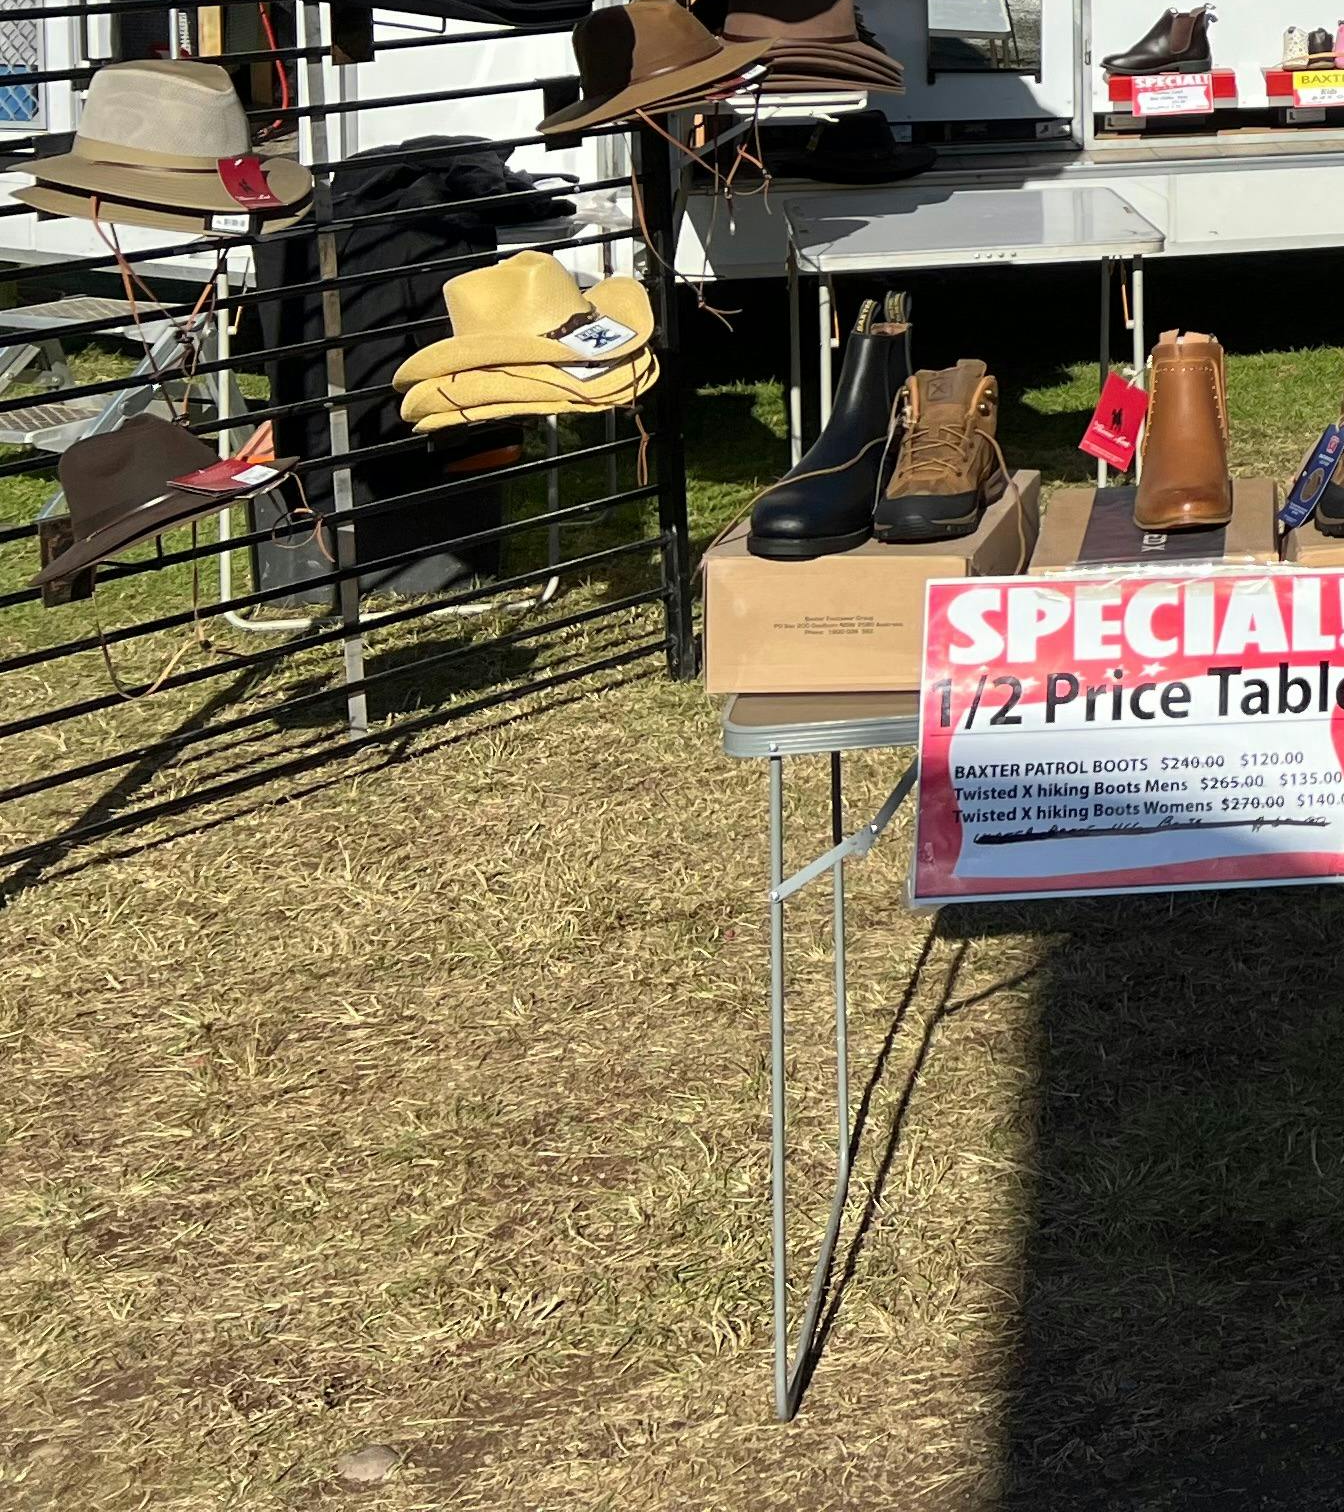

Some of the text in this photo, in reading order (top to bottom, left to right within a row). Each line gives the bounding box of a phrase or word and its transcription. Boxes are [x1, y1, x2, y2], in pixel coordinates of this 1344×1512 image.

[930, 674, 1024, 731] 1/2
[1045, 668, 1193, 724] Price
[955, 751, 1304, 779] BAXTER PATROL BOOTS $240.00 $120.00
[954, 771, 1343, 802] Twisted X hiking Boots Mens $265.00 $135.00
[953, 809, 1017, 824] Twisted
[1021, 806, 1033, 821] X
[1036, 805, 1089, 822] hiking
[1093, 802, 1140, 818] Boots
[1143, 800, 1213, 815] Womens
[1221, 795, 1285, 812] $270.00
